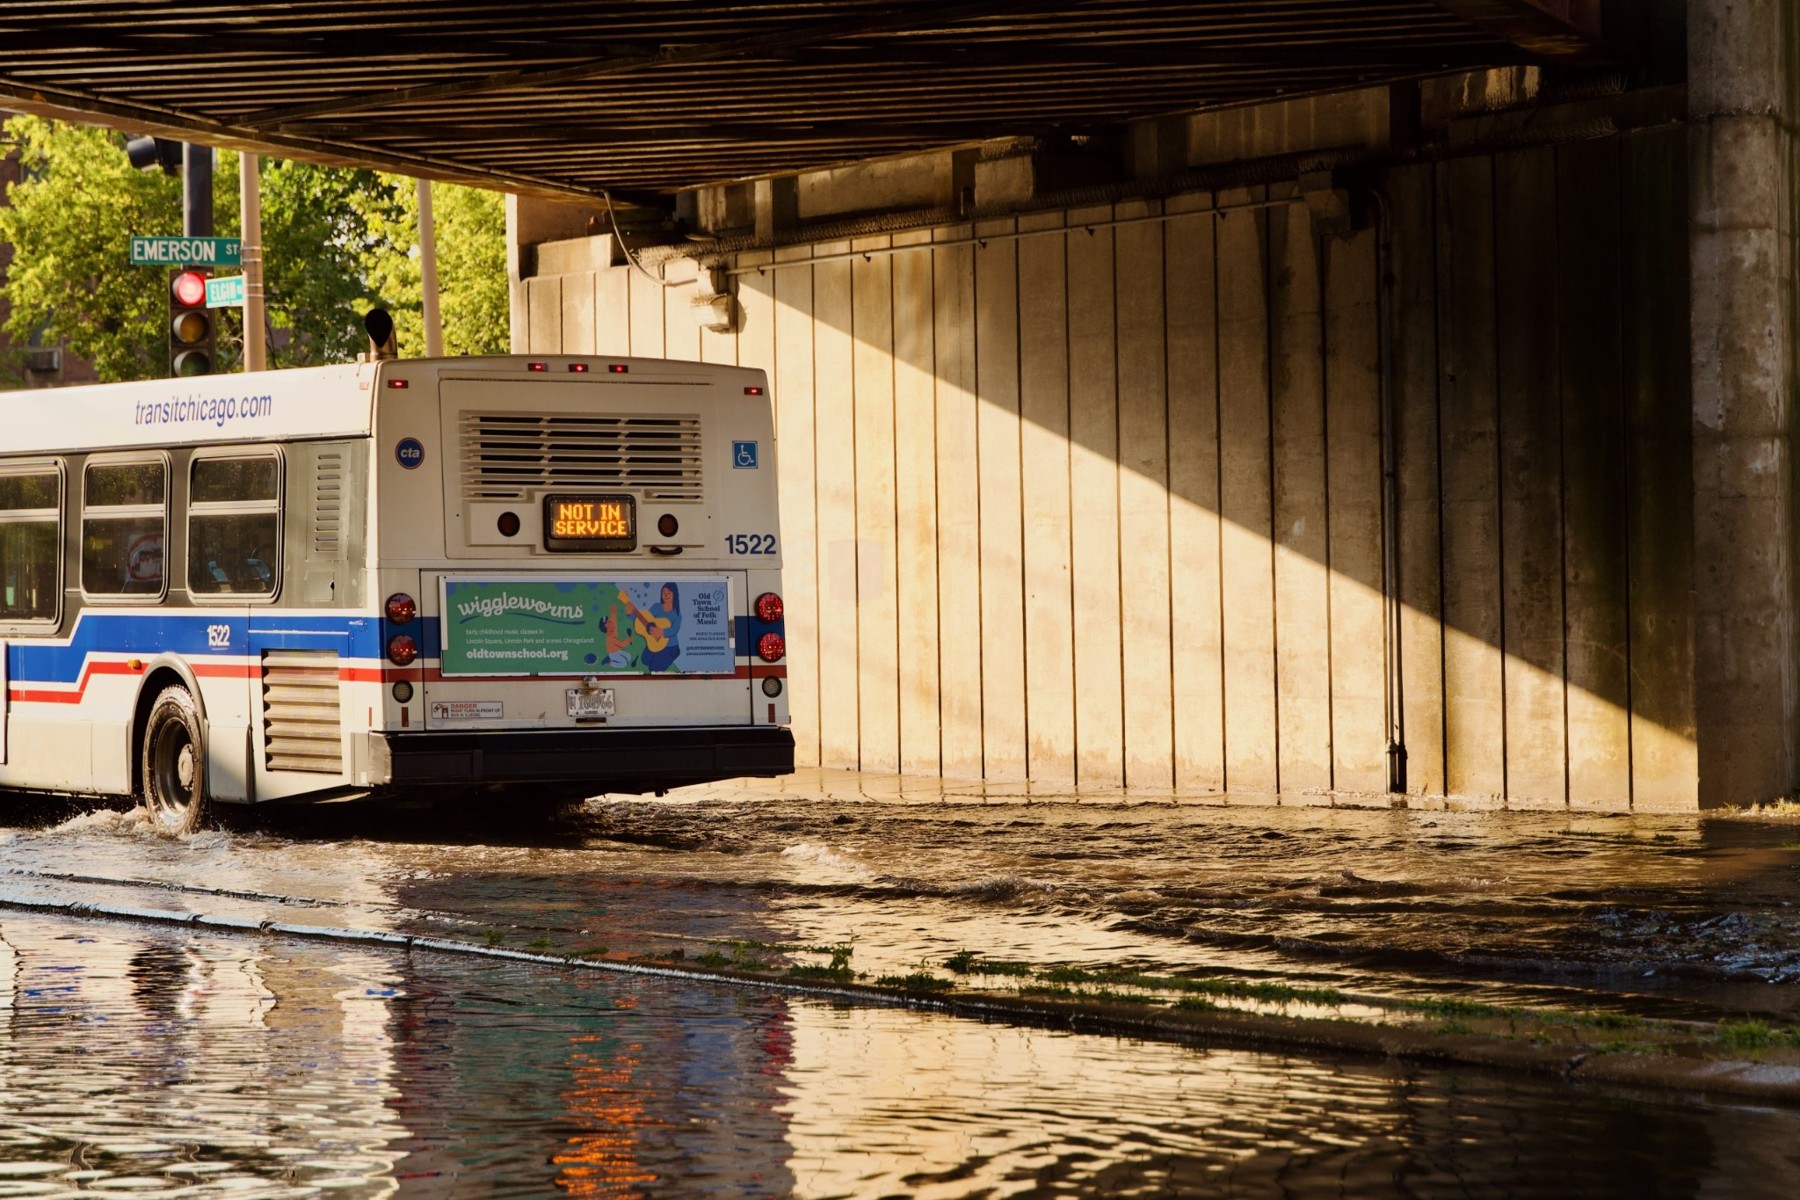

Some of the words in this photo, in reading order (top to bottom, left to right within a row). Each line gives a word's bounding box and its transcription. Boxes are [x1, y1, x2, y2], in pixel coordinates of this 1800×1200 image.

[133, 239, 216, 261] EMERSON
[225, 243, 239, 255] ST
[135, 394, 272, 427] transitchicago.com
[400, 447, 420, 458] cta
[560, 504, 594, 520] NOT
[600, 504, 621, 520] IN
[555, 521, 627, 535] SERVICE
[724, 533, 777, 555] 1522
[457, 591, 583, 619] wiggleworms
[698, 592, 711, 600] Old
[207, 624, 231, 647] 1522
[466, 648, 569, 661] oldtownschool.org
